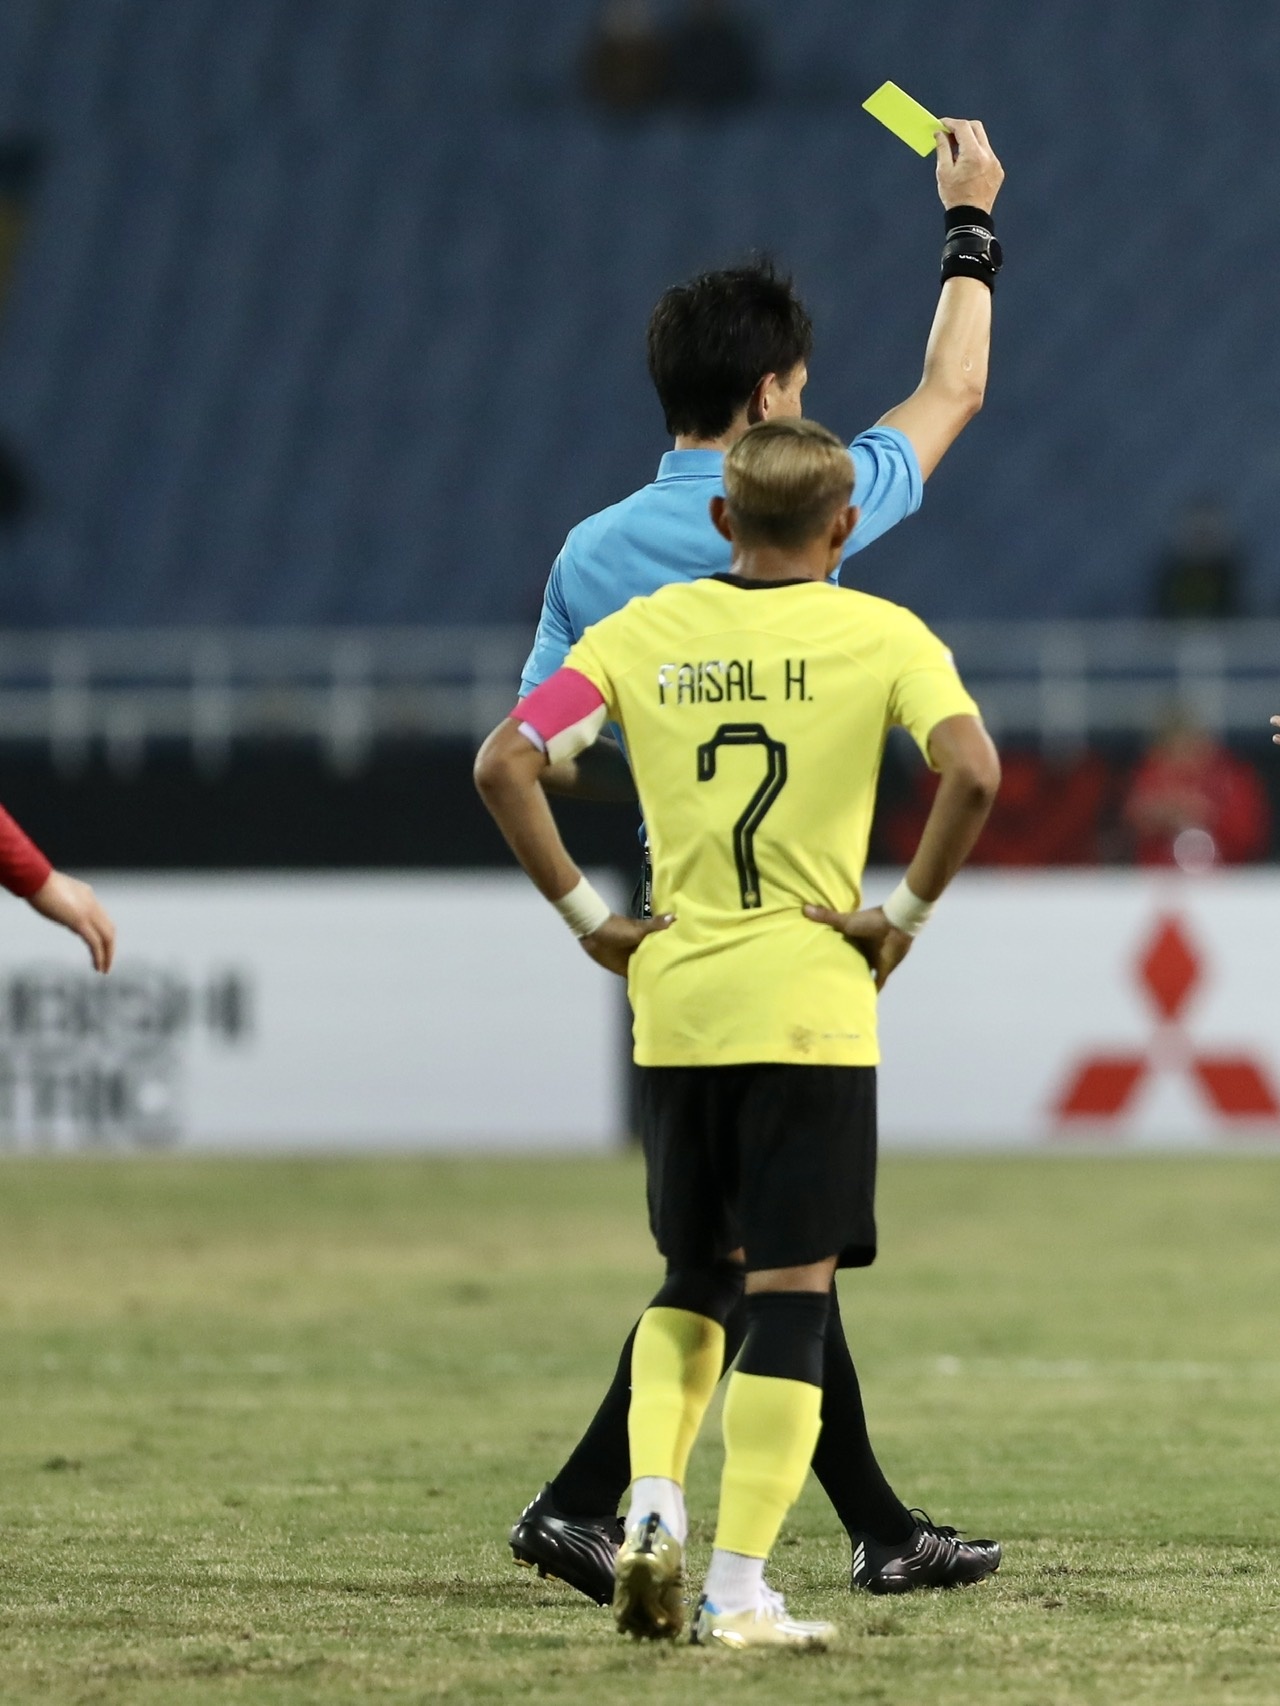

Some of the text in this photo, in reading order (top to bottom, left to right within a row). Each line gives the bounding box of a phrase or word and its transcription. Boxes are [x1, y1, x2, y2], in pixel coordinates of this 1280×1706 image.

[658, 659, 813, 705] FAISAL H.
[697, 723, 787, 910] 7
